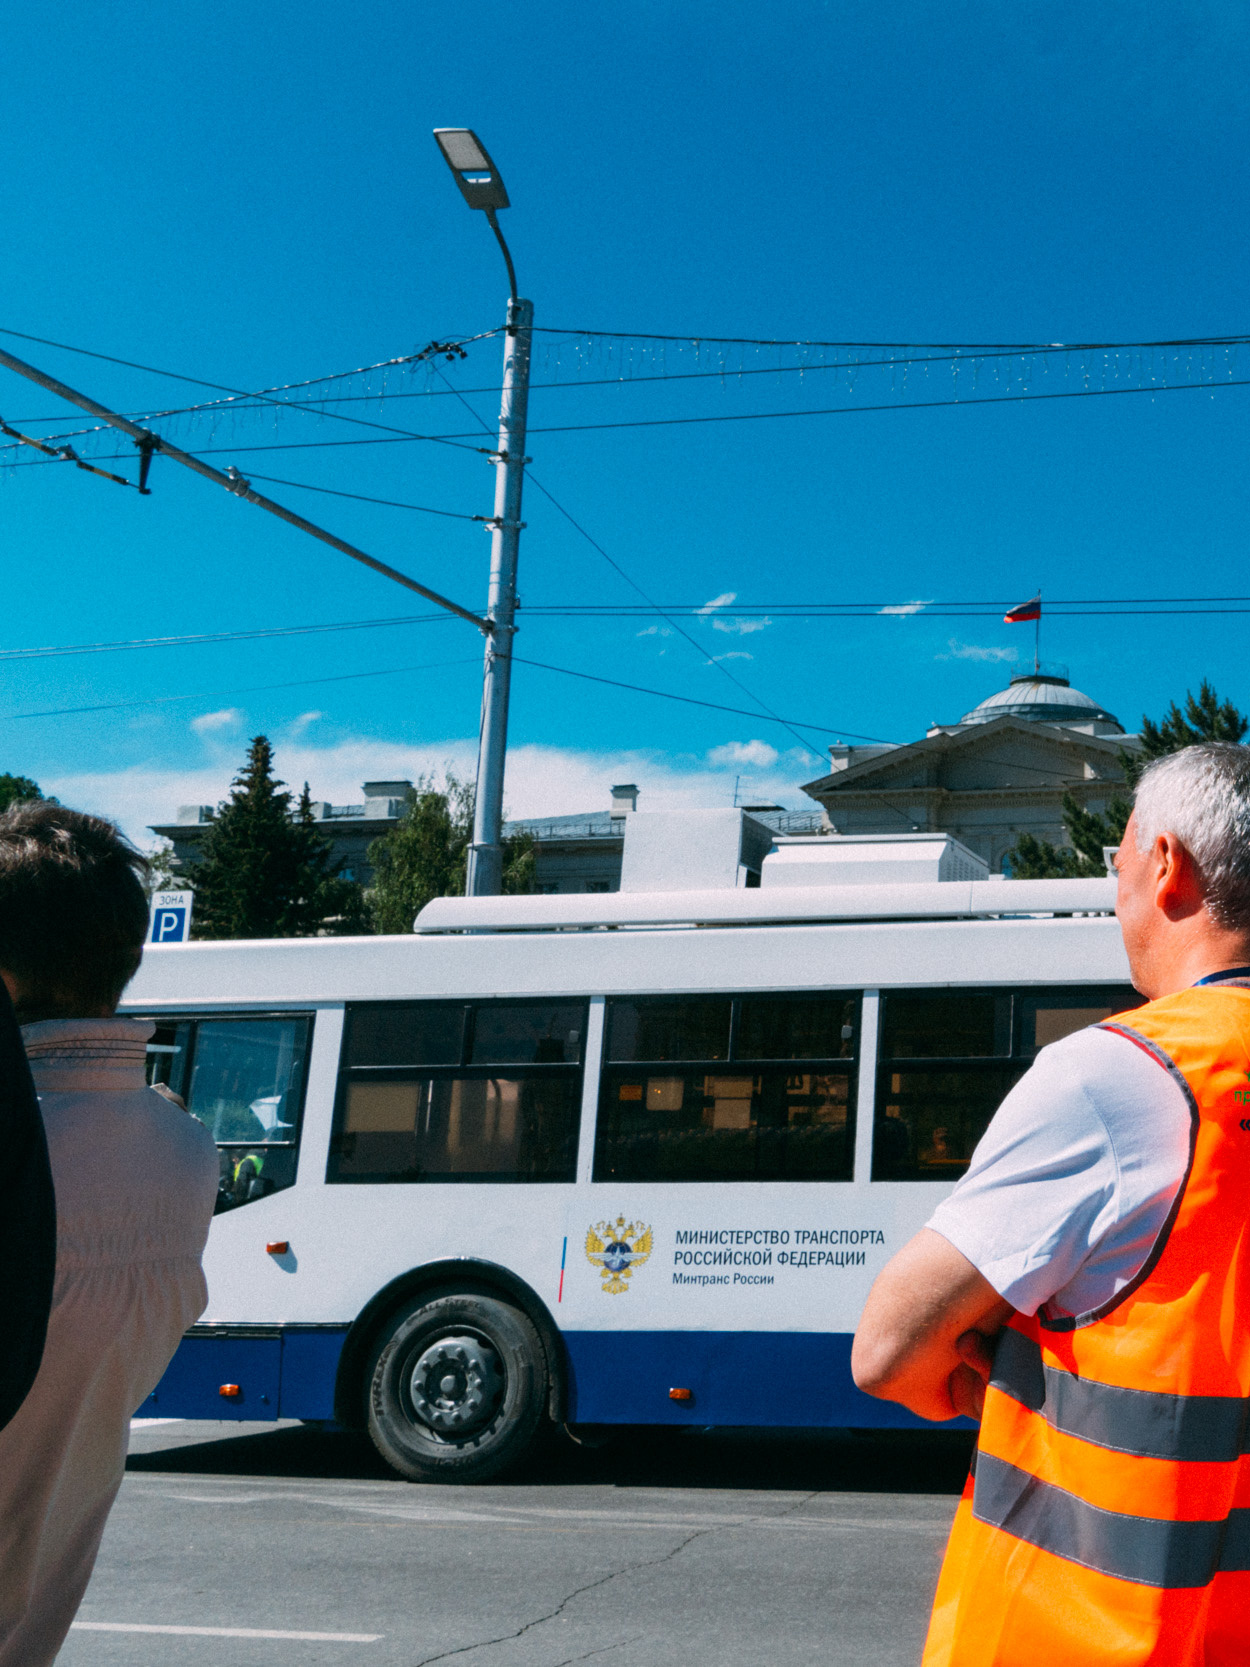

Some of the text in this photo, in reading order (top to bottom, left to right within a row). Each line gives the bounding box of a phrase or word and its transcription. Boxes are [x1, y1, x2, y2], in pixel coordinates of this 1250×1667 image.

[160, 894, 184, 906] ЗОНА
[675, 1230, 885, 1246] МИНИСТЕРСТВО ТРАНСПОРТА
[674, 1248, 866, 1268] РОССИЙСКОЙ ФЕДЕРАЦИИ
[672, 1272, 775, 1287] Минтранс России
